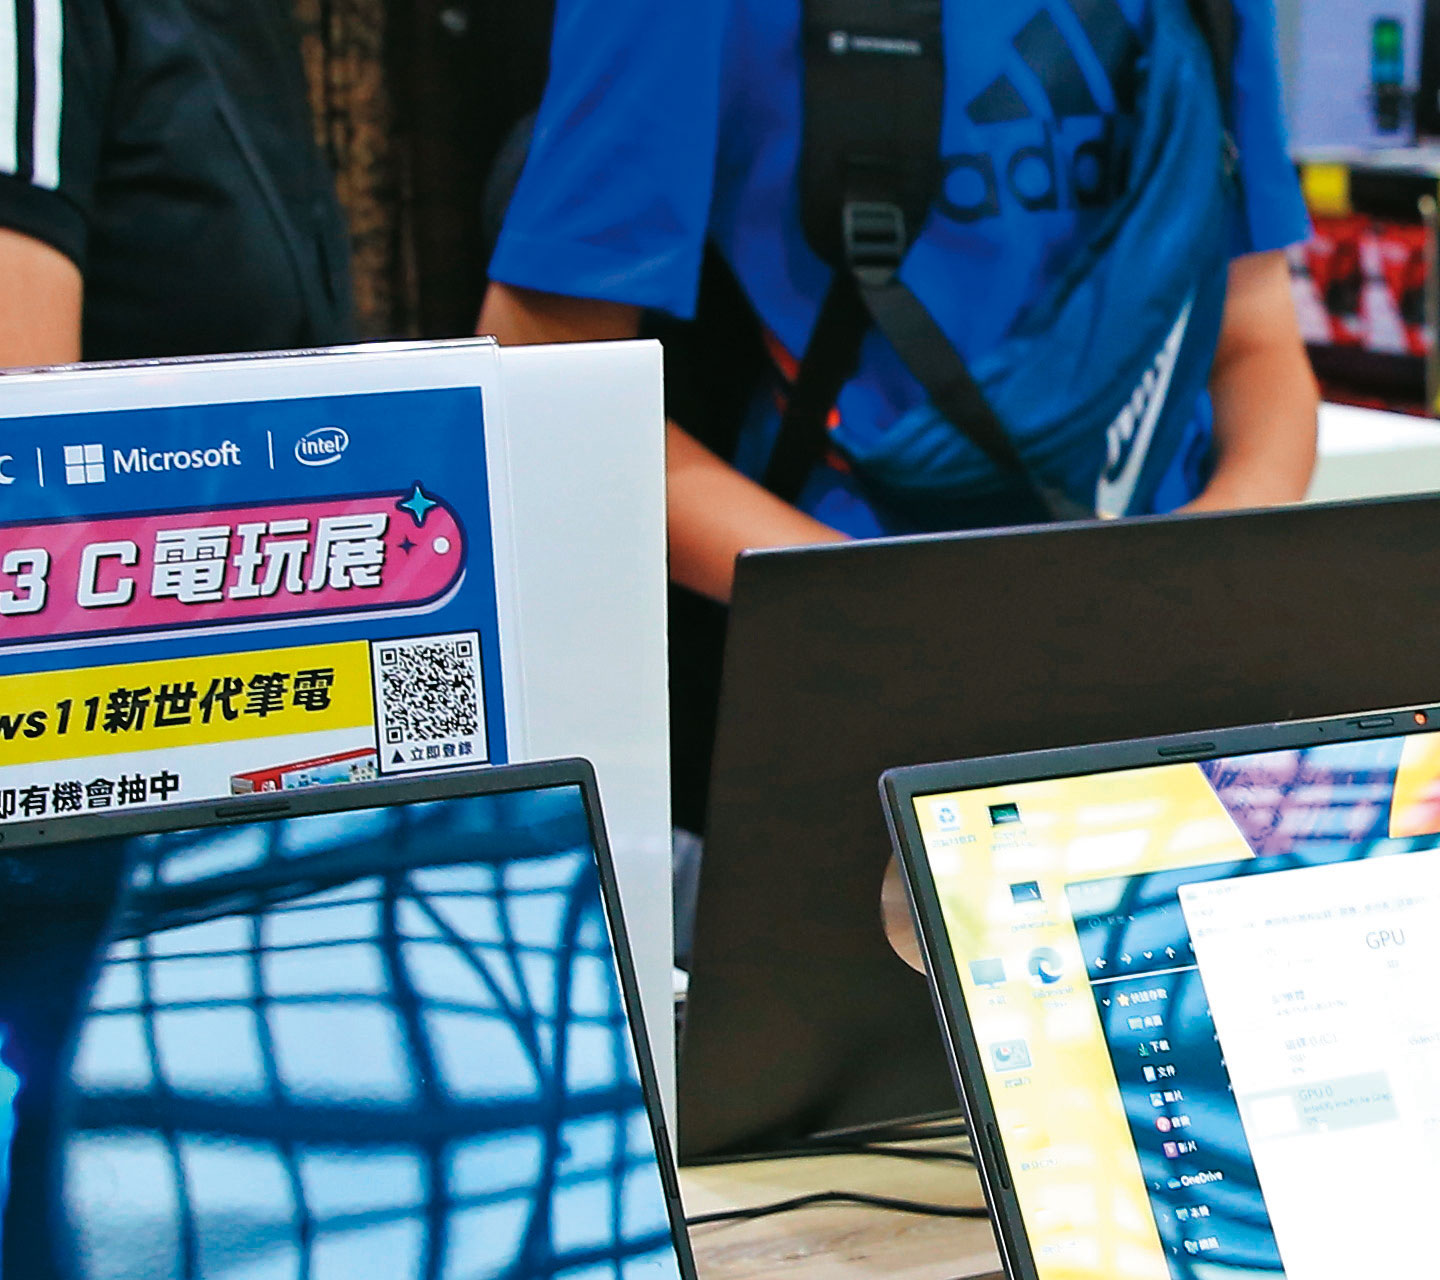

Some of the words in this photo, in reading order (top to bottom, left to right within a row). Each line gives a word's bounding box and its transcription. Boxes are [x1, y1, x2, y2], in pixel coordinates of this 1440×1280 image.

[113, 440, 242, 474] Microsoft
[409, 740, 473, 762] 立即登錄
[1365, 928, 1407, 950] GPU
[1180, 1170, 1224, 1187] OneDrive
